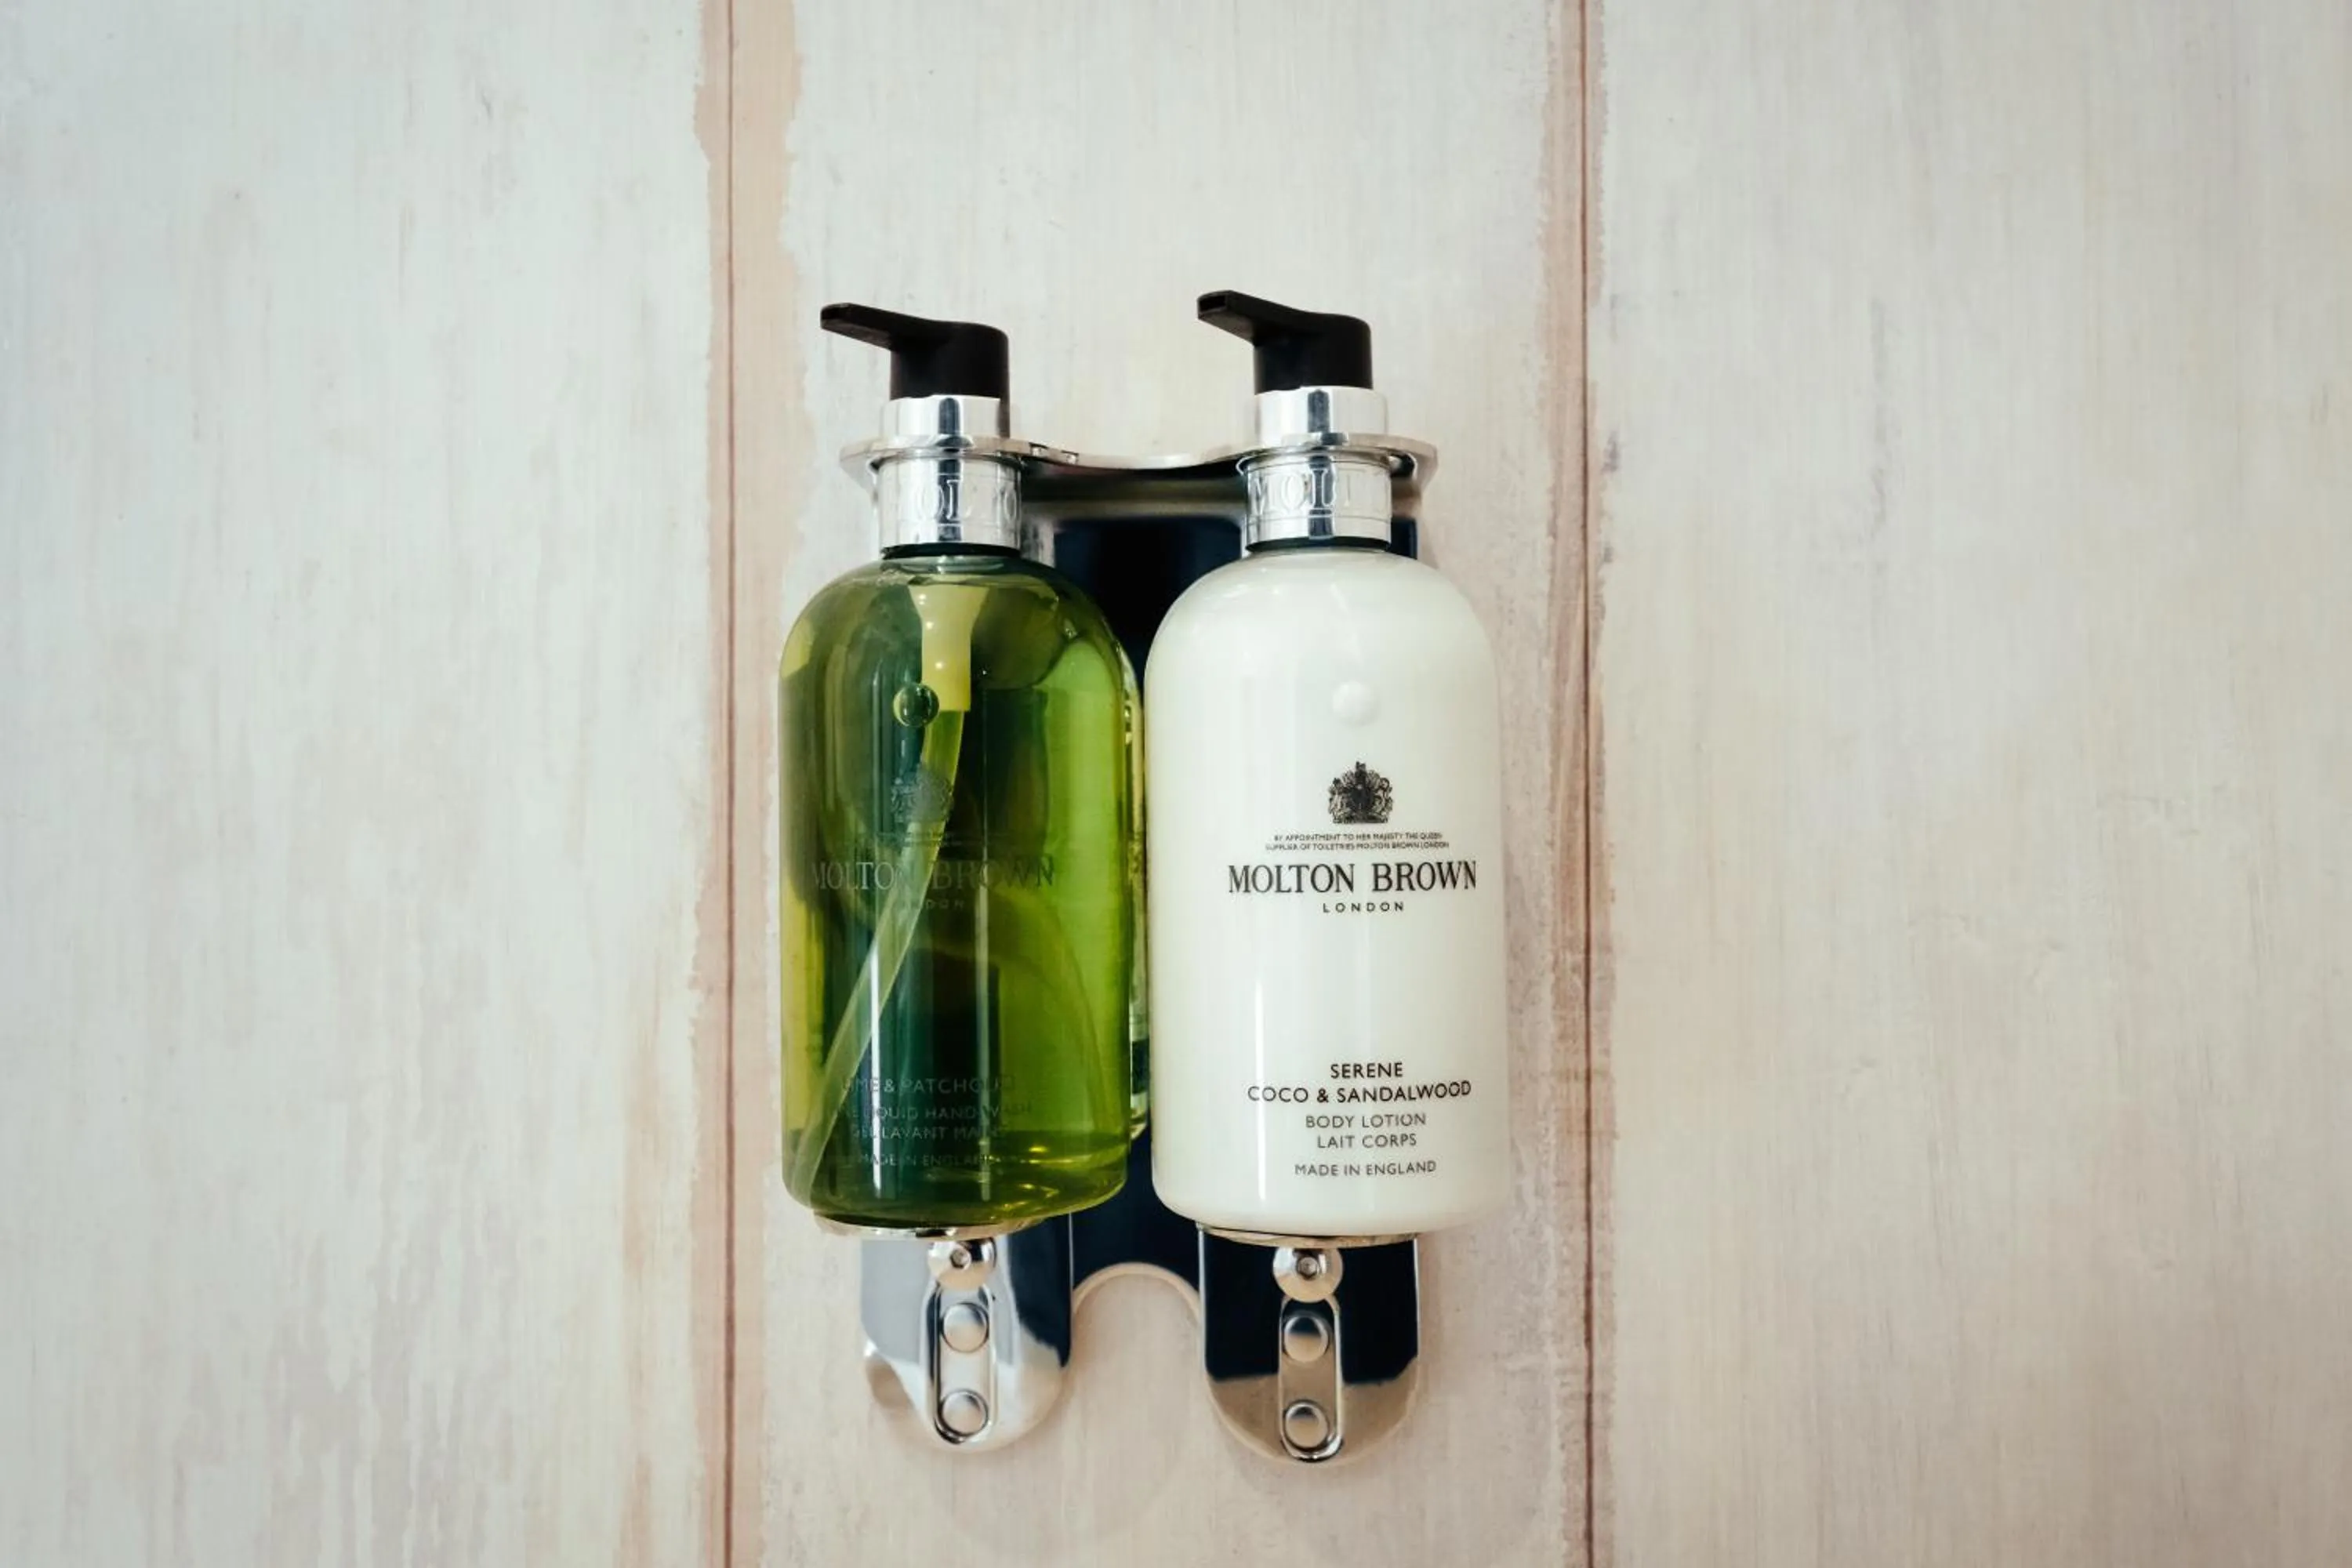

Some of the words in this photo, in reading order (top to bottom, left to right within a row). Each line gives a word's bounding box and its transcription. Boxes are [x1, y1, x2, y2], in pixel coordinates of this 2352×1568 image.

[1228, 864, 1355, 893] MOLTON
[1372, 861, 1476, 892] BROWN
[1323, 902, 1403, 913] LONDON
[1330, 1062, 1403, 1079] SERENE
[884, 1078, 895, 1092] &
[1248, 1086, 1308, 1103] COCO
[1317, 1088, 1329, 1103] &
[1337, 1080, 1472, 1103] SANDALWOOD
[1305, 1115, 1355, 1128] BODY
[1362, 1113, 1426, 1127] LOTION
[1317, 1134, 1353, 1149] LAIT
[1362, 1133, 1417, 1148] CORPS
[1294, 1163, 1338, 1176] MADE
[1344, 1163, 1360, 1176] IN
[1366, 1160, 1437, 1175] ENGLAND
